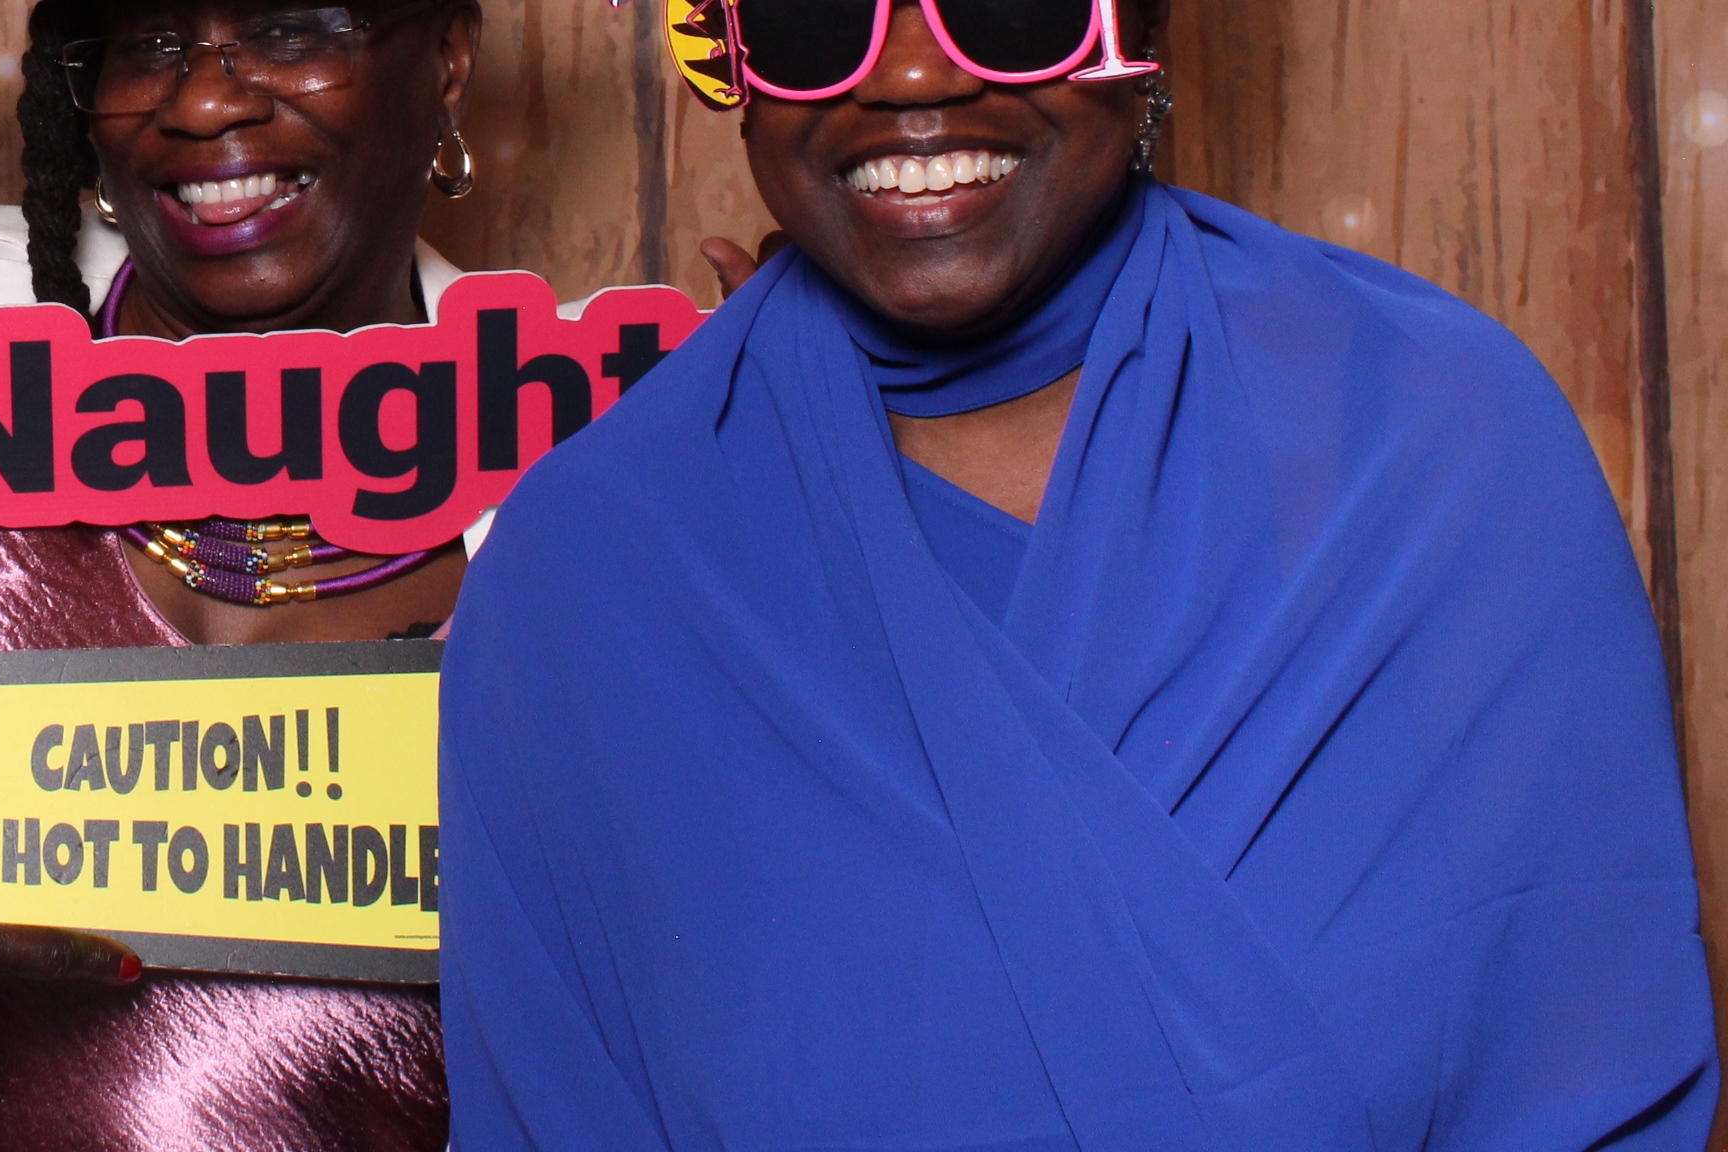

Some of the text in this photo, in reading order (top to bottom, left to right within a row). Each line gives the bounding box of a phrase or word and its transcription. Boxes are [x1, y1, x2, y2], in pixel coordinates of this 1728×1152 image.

[30, 706, 343, 801] CAUTION!!
[2, 817, 120, 889] HOT
[133, 820, 209, 894] TO
[223, 822, 440, 912] HANDLE
